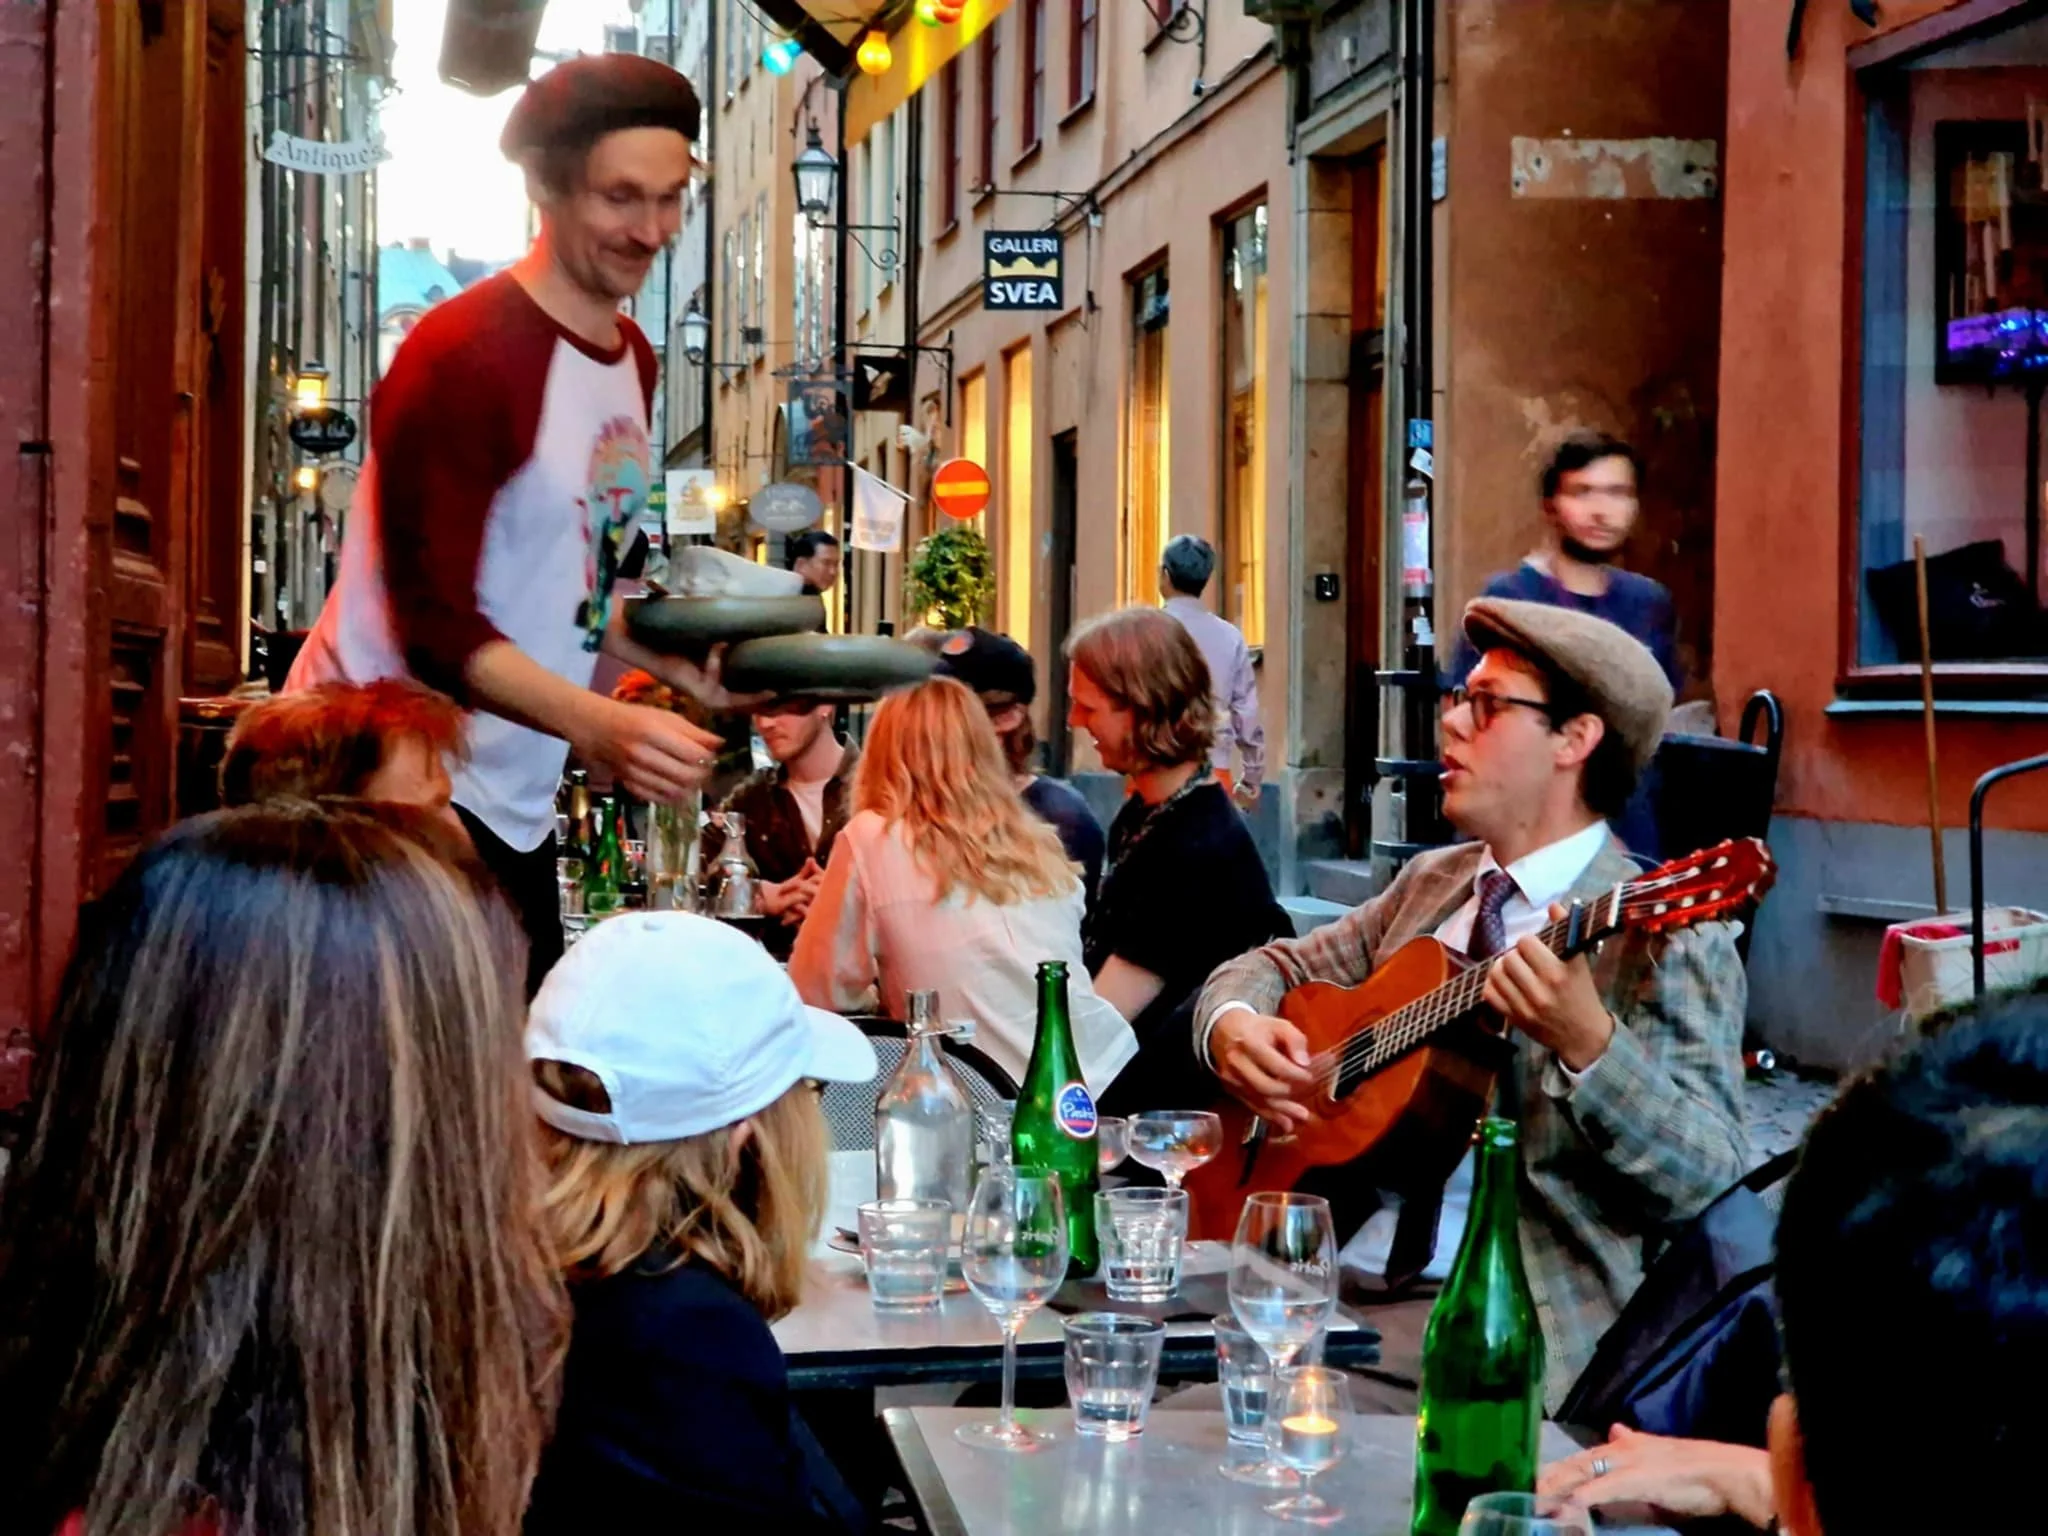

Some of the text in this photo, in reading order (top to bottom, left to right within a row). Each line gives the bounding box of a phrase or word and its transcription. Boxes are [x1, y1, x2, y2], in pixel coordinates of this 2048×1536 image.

[275, 140, 382, 169] Antiques
[989, 238, 1058, 254] GALLERI
[989, 281, 1058, 304] SVEA
